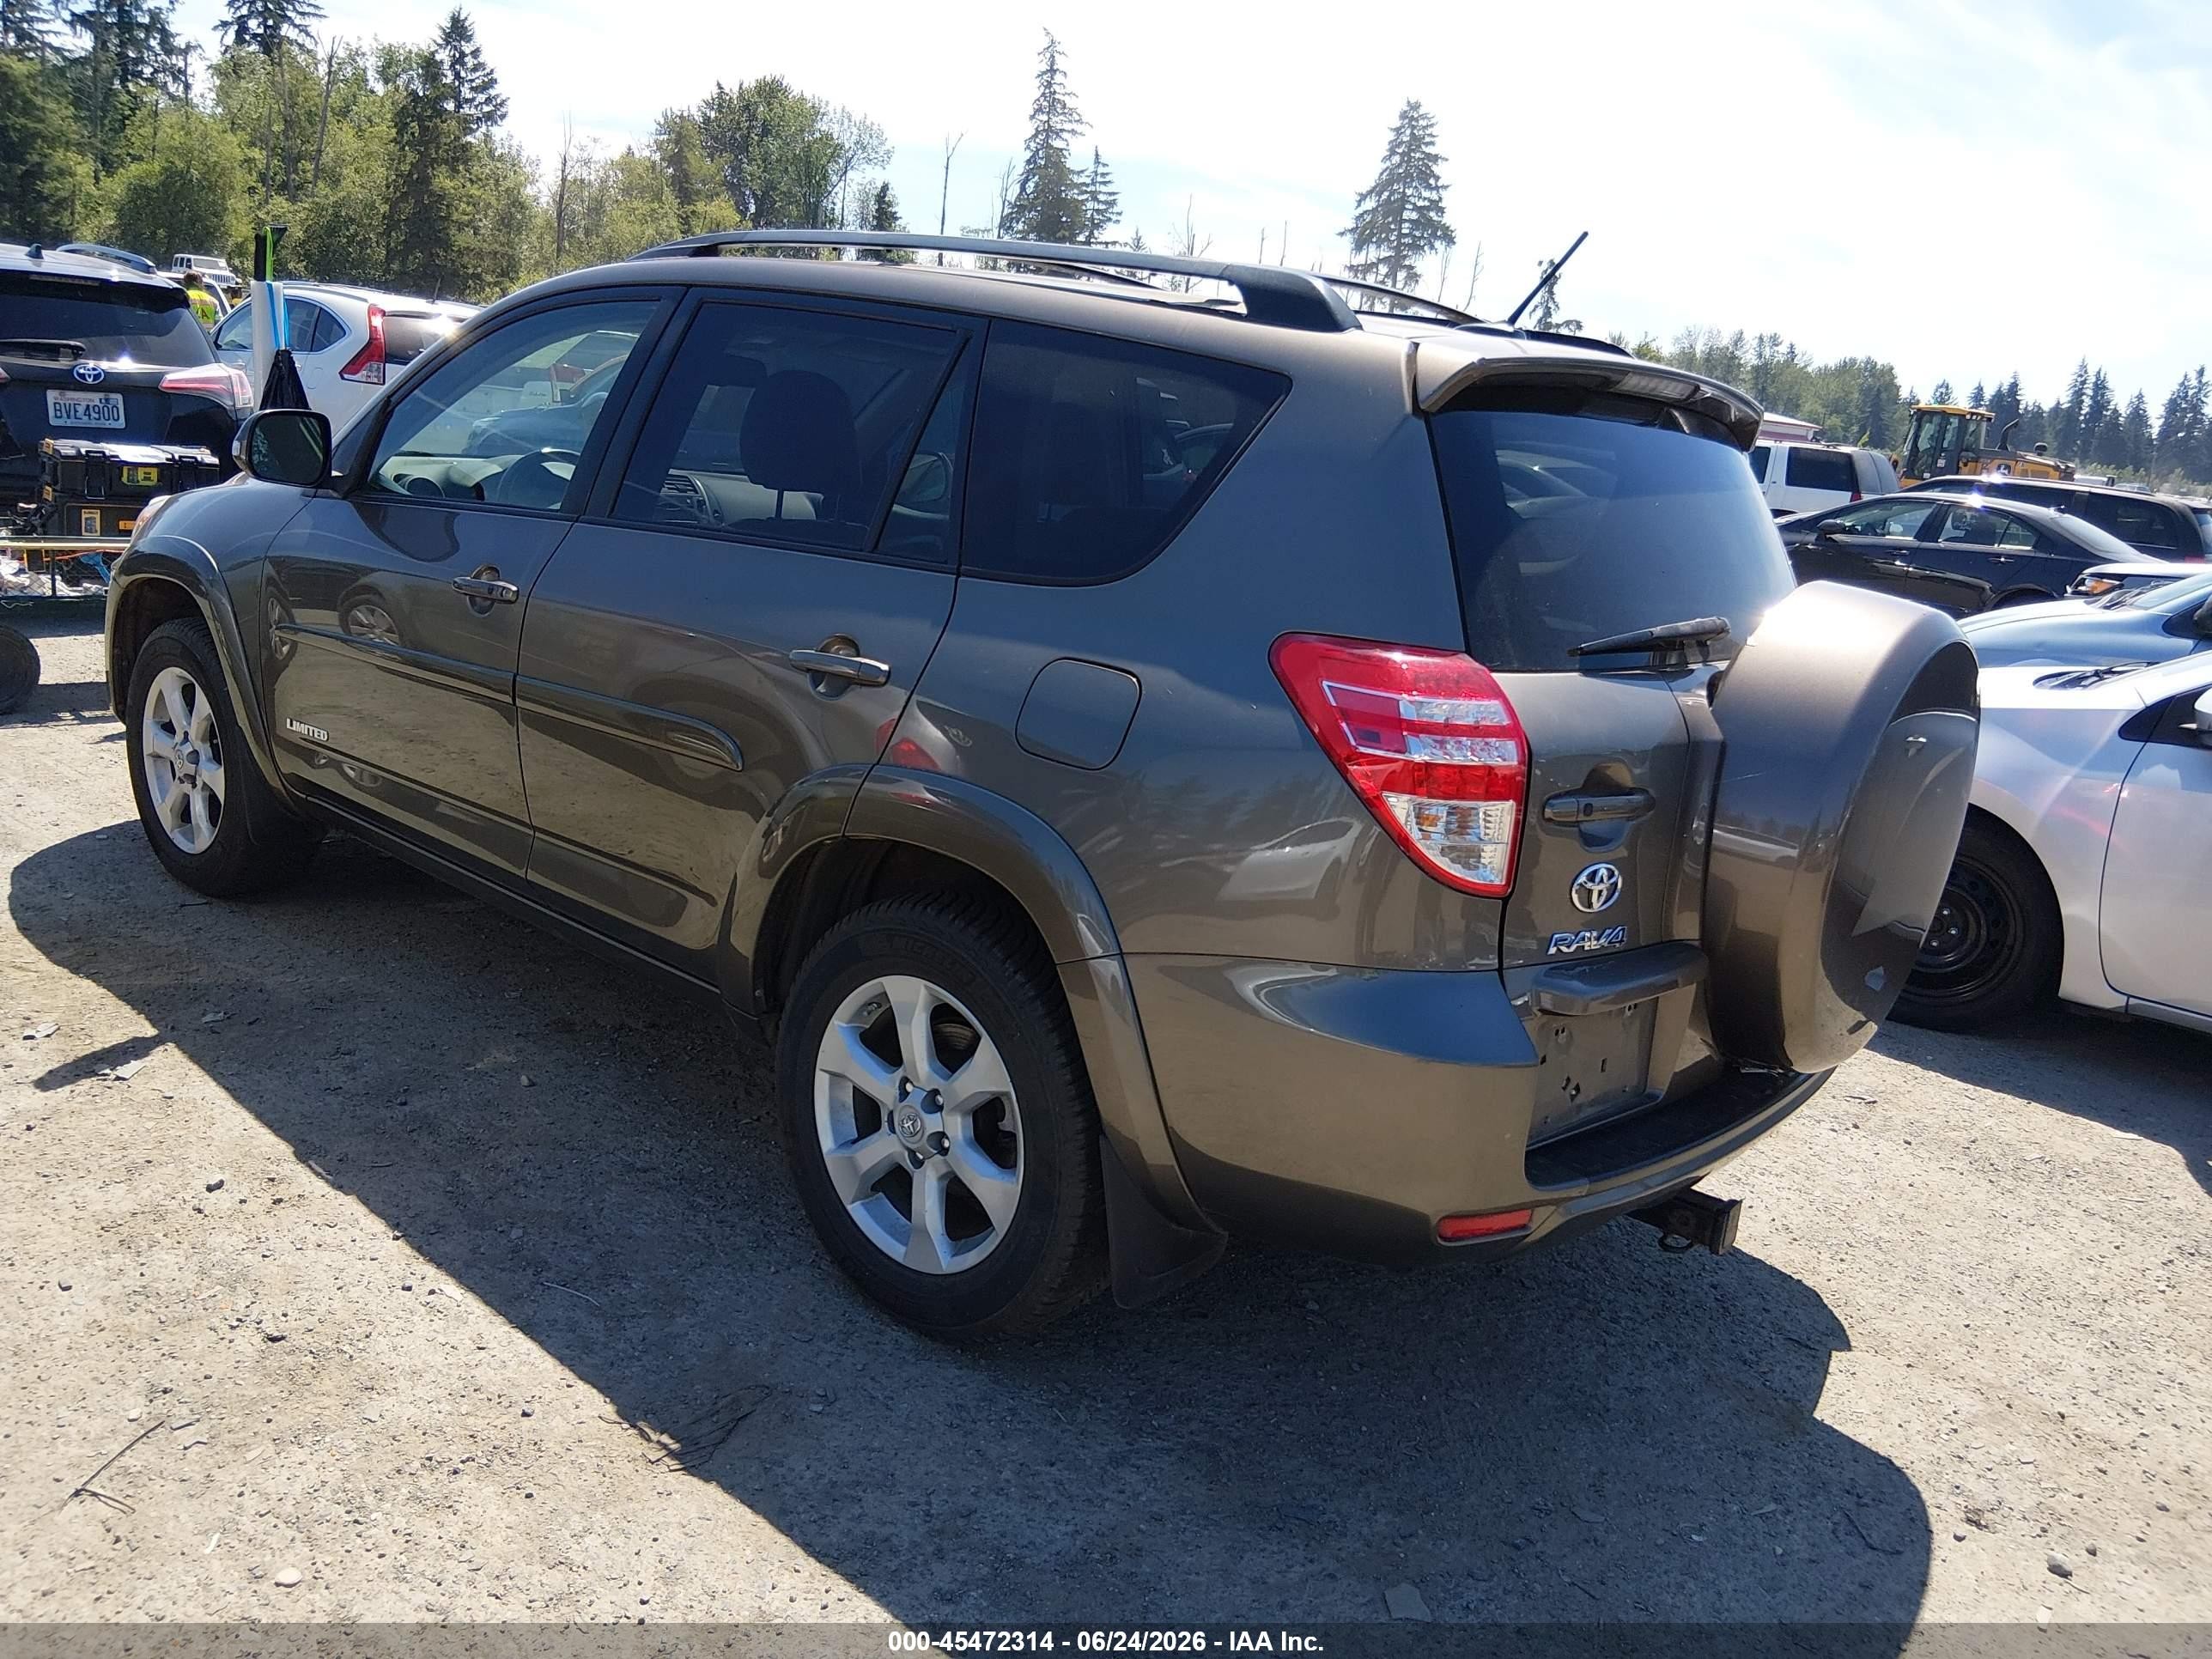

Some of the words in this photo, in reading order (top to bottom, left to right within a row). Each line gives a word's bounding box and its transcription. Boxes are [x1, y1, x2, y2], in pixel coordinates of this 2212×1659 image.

[53, 402, 120, 422] BVE4900
[286, 718, 328, 741] LIMITED
[1547, 926, 1627, 955] RAV4
